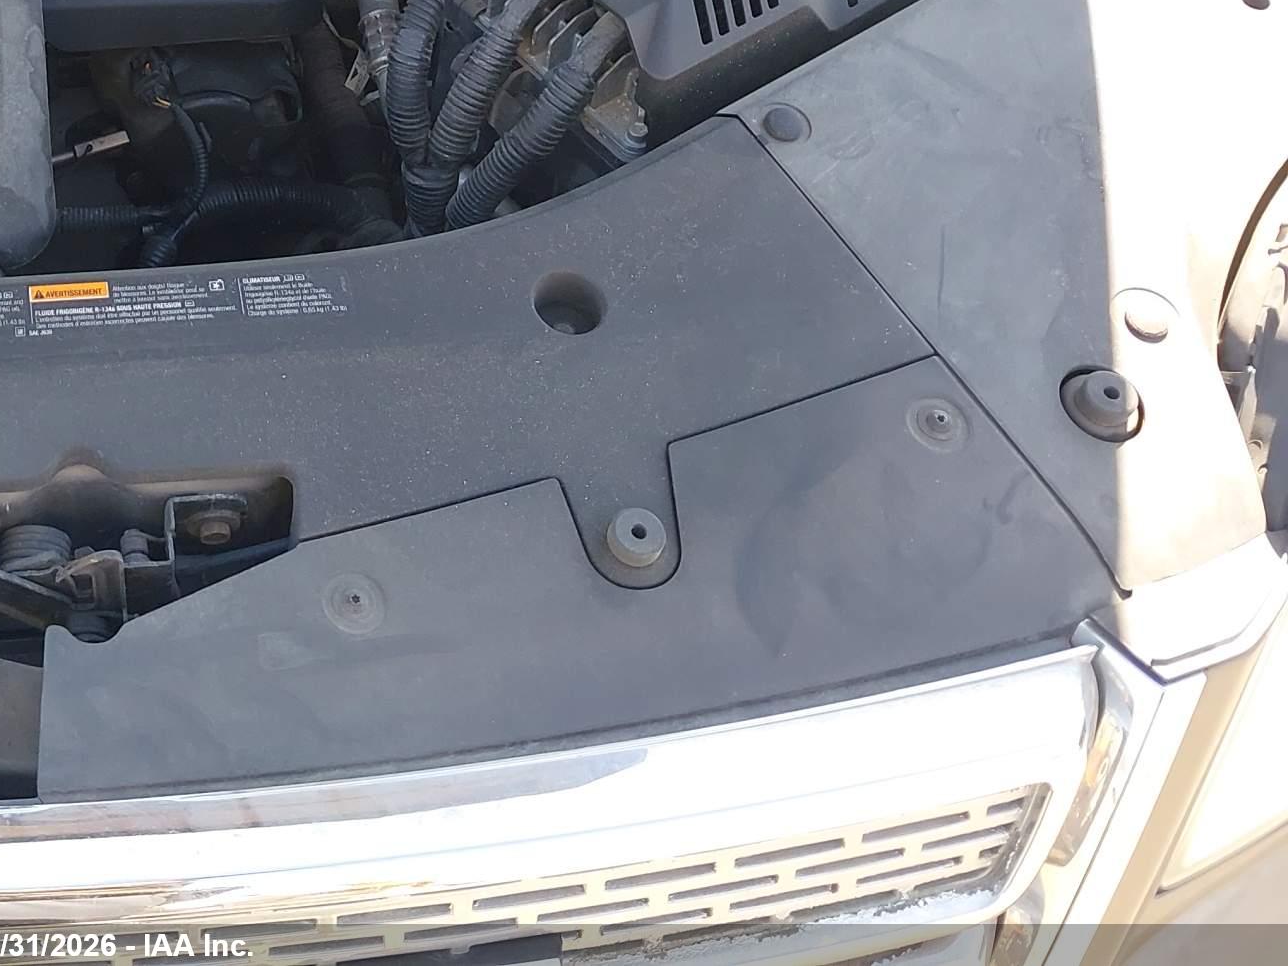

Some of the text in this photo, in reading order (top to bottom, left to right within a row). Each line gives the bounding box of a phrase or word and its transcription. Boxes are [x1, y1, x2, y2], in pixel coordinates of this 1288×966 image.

[243, 275, 281, 283] CLIMATISEUR
[45, 288, 102, 298] AVERTISSEMENT
[35, 309, 55, 317] FLUIDE
[133, 303, 152, 311] HAUTE
[153, 301, 182, 309] PRESSION
